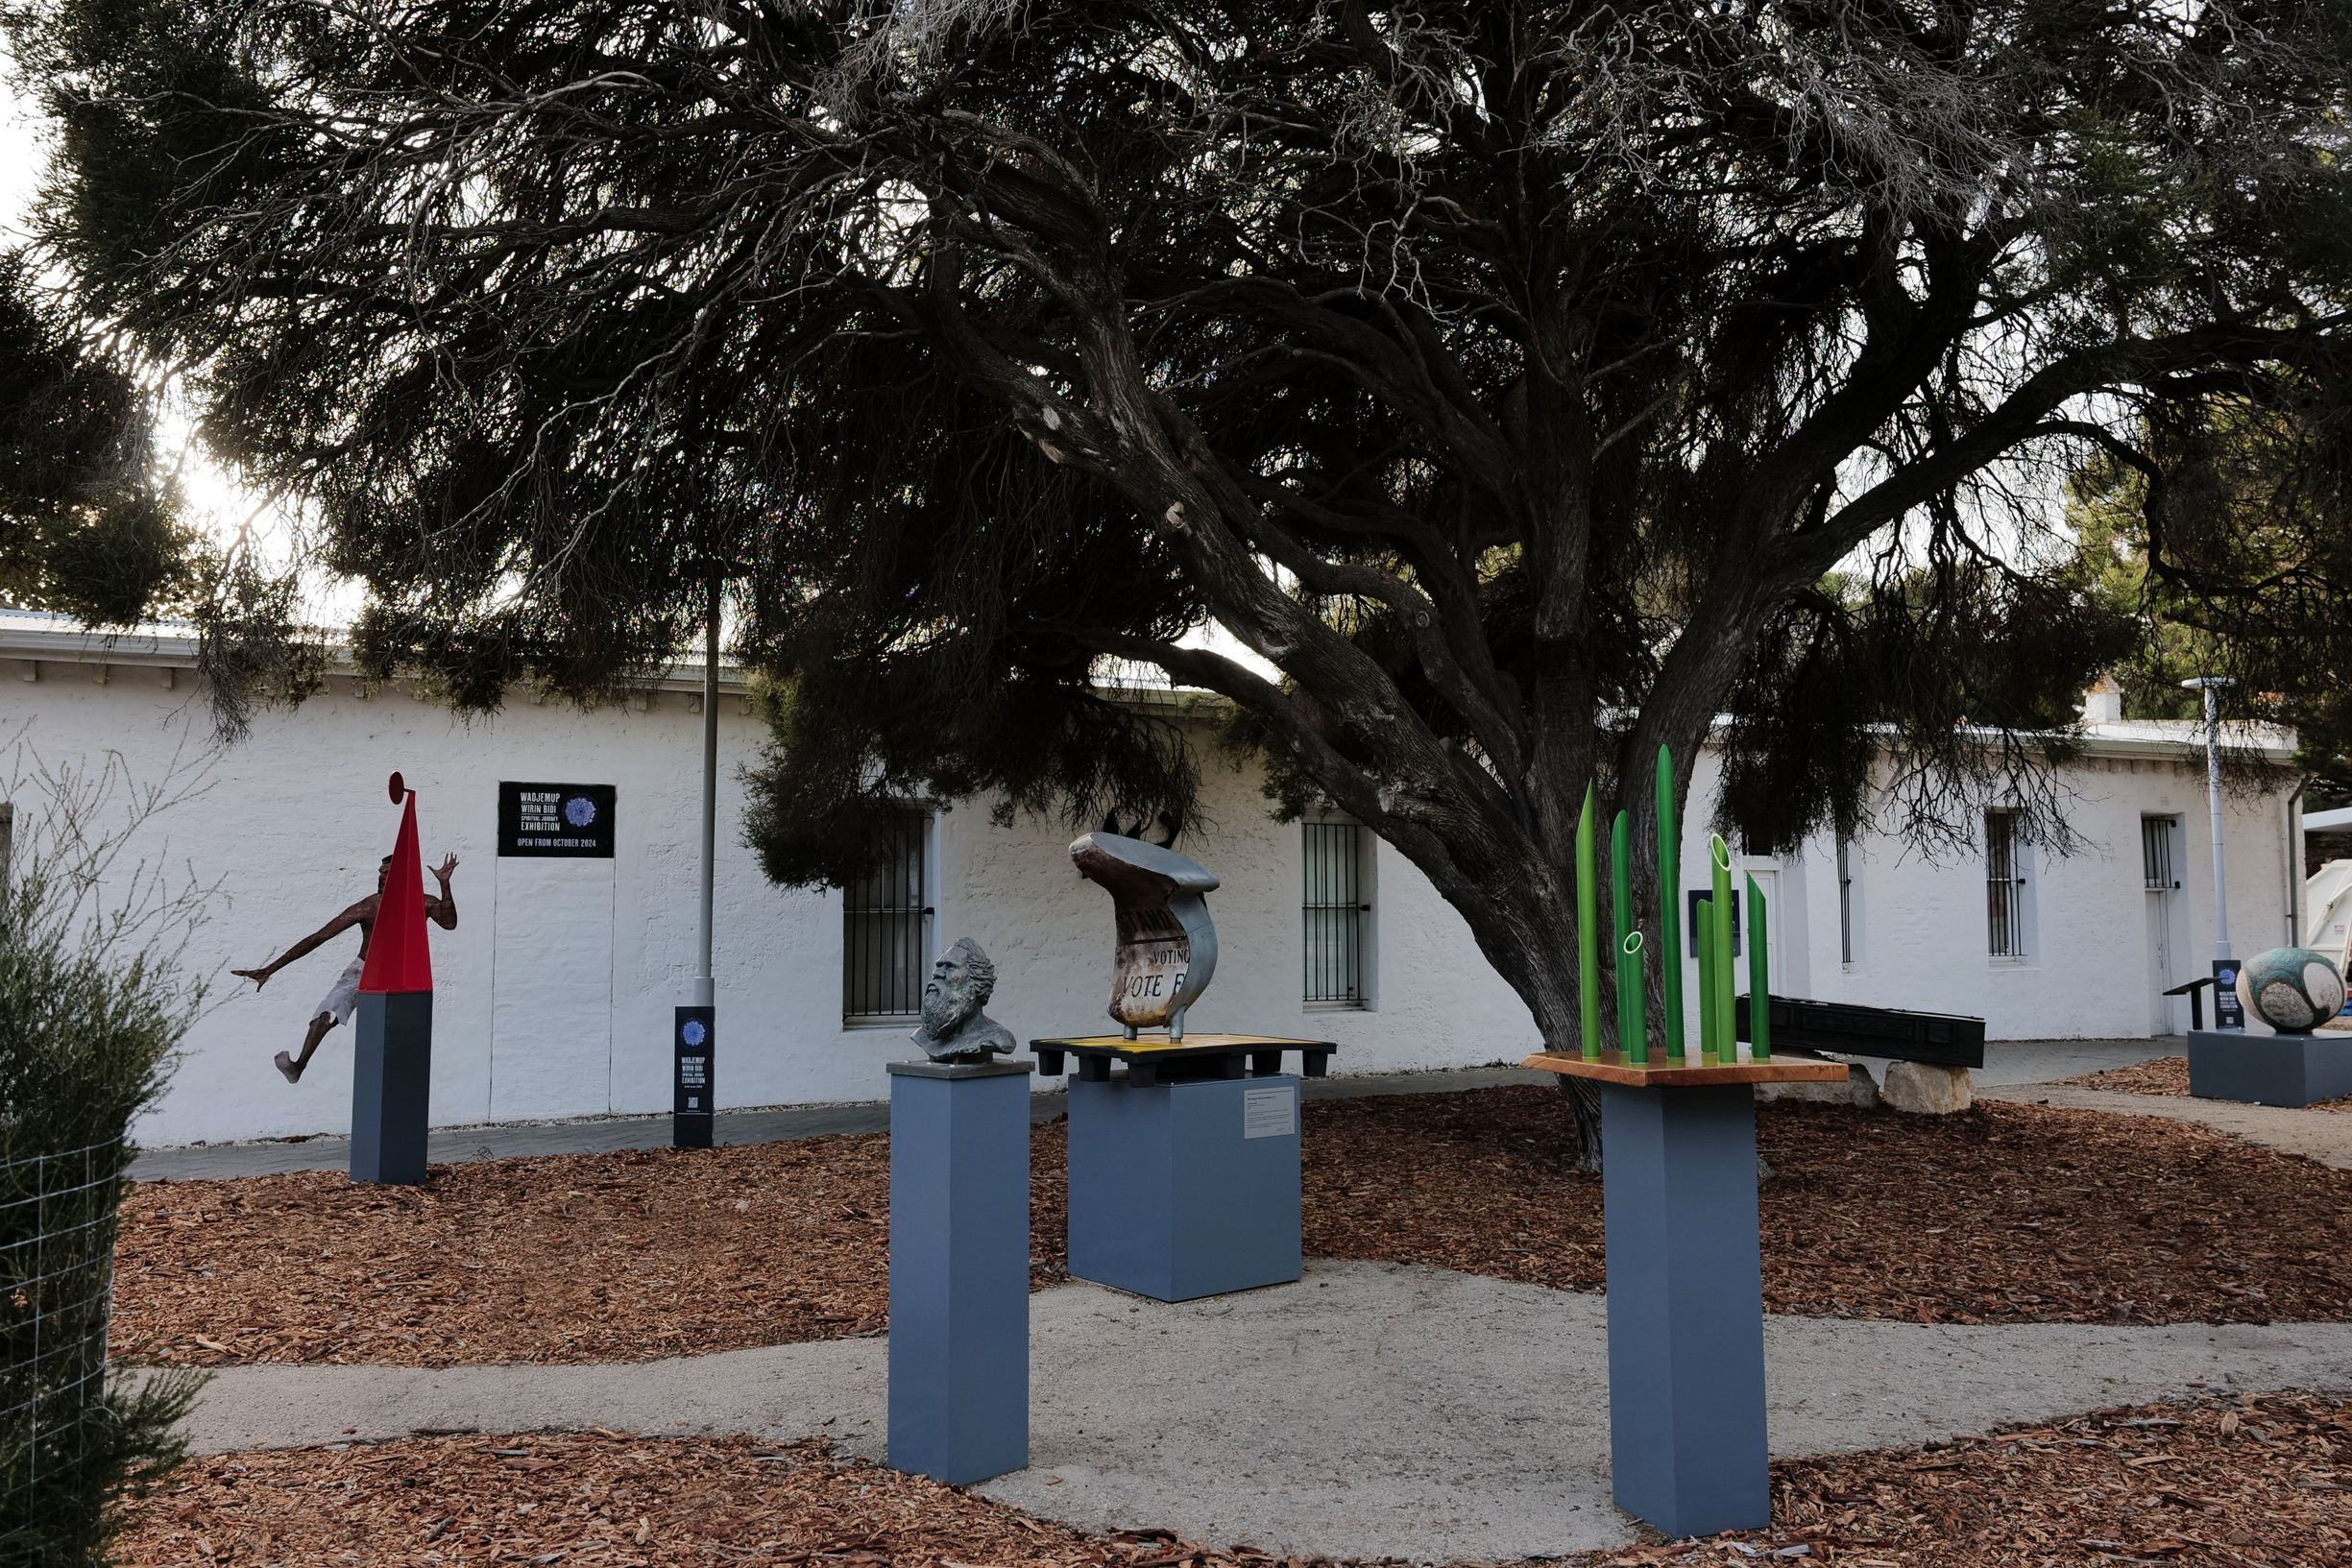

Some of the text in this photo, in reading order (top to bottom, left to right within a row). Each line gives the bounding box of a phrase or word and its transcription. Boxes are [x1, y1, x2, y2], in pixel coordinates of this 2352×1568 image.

[521, 792, 561, 803] WADJEMUP
[521, 804, 557, 814] WIRIN BIDI
[521, 822, 561, 832] EXHIBITION
[518, 837, 596, 848] OPEN FROM OCTOBER 2024
[1153, 949, 1190, 964] VOTING
[1123, 974, 1163, 998] VOTE
